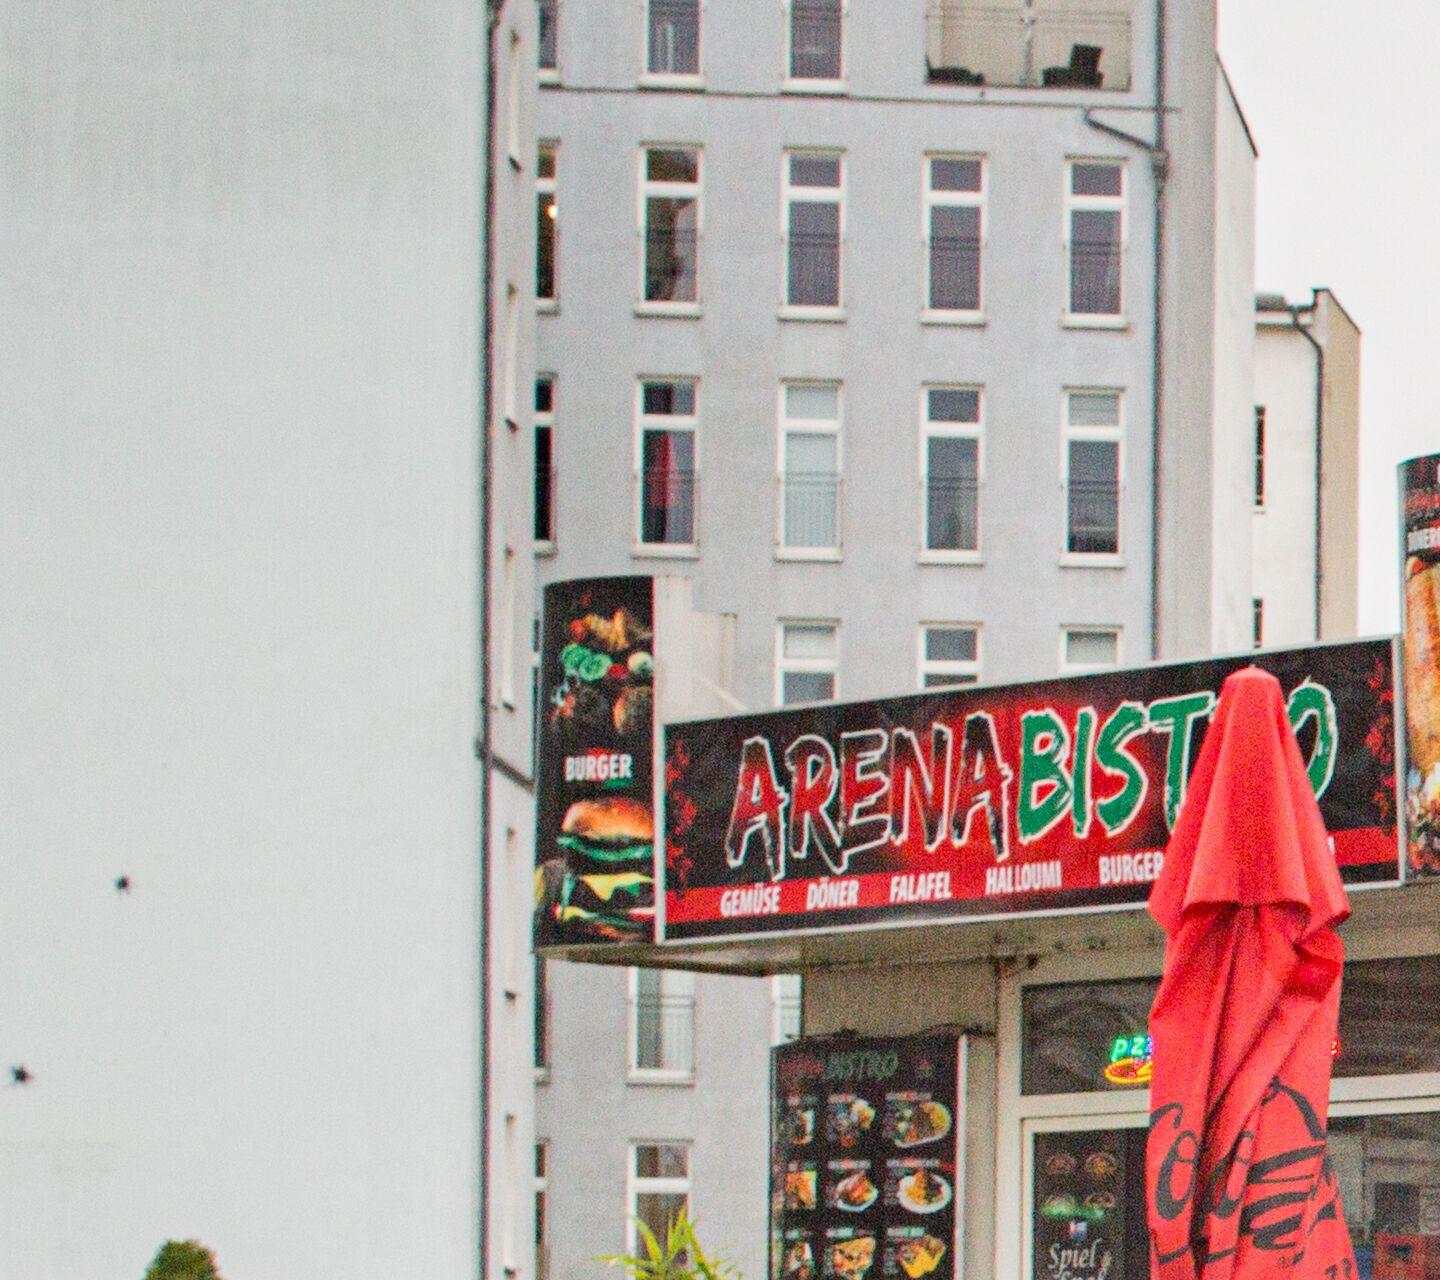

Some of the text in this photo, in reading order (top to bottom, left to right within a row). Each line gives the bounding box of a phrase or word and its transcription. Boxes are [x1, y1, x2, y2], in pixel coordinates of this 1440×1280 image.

[564, 751, 633, 783] BURGER
[725, 680, 1338, 882] ARENA BISTO
[719, 876, 781, 920] GEMÜSE
[806, 874, 861, 913] DÖNER
[889, 868, 952, 904] FALAFEL
[984, 858, 1063, 895] HALLOUMI
[1048, 1238, 1101, 1277] Spiel
